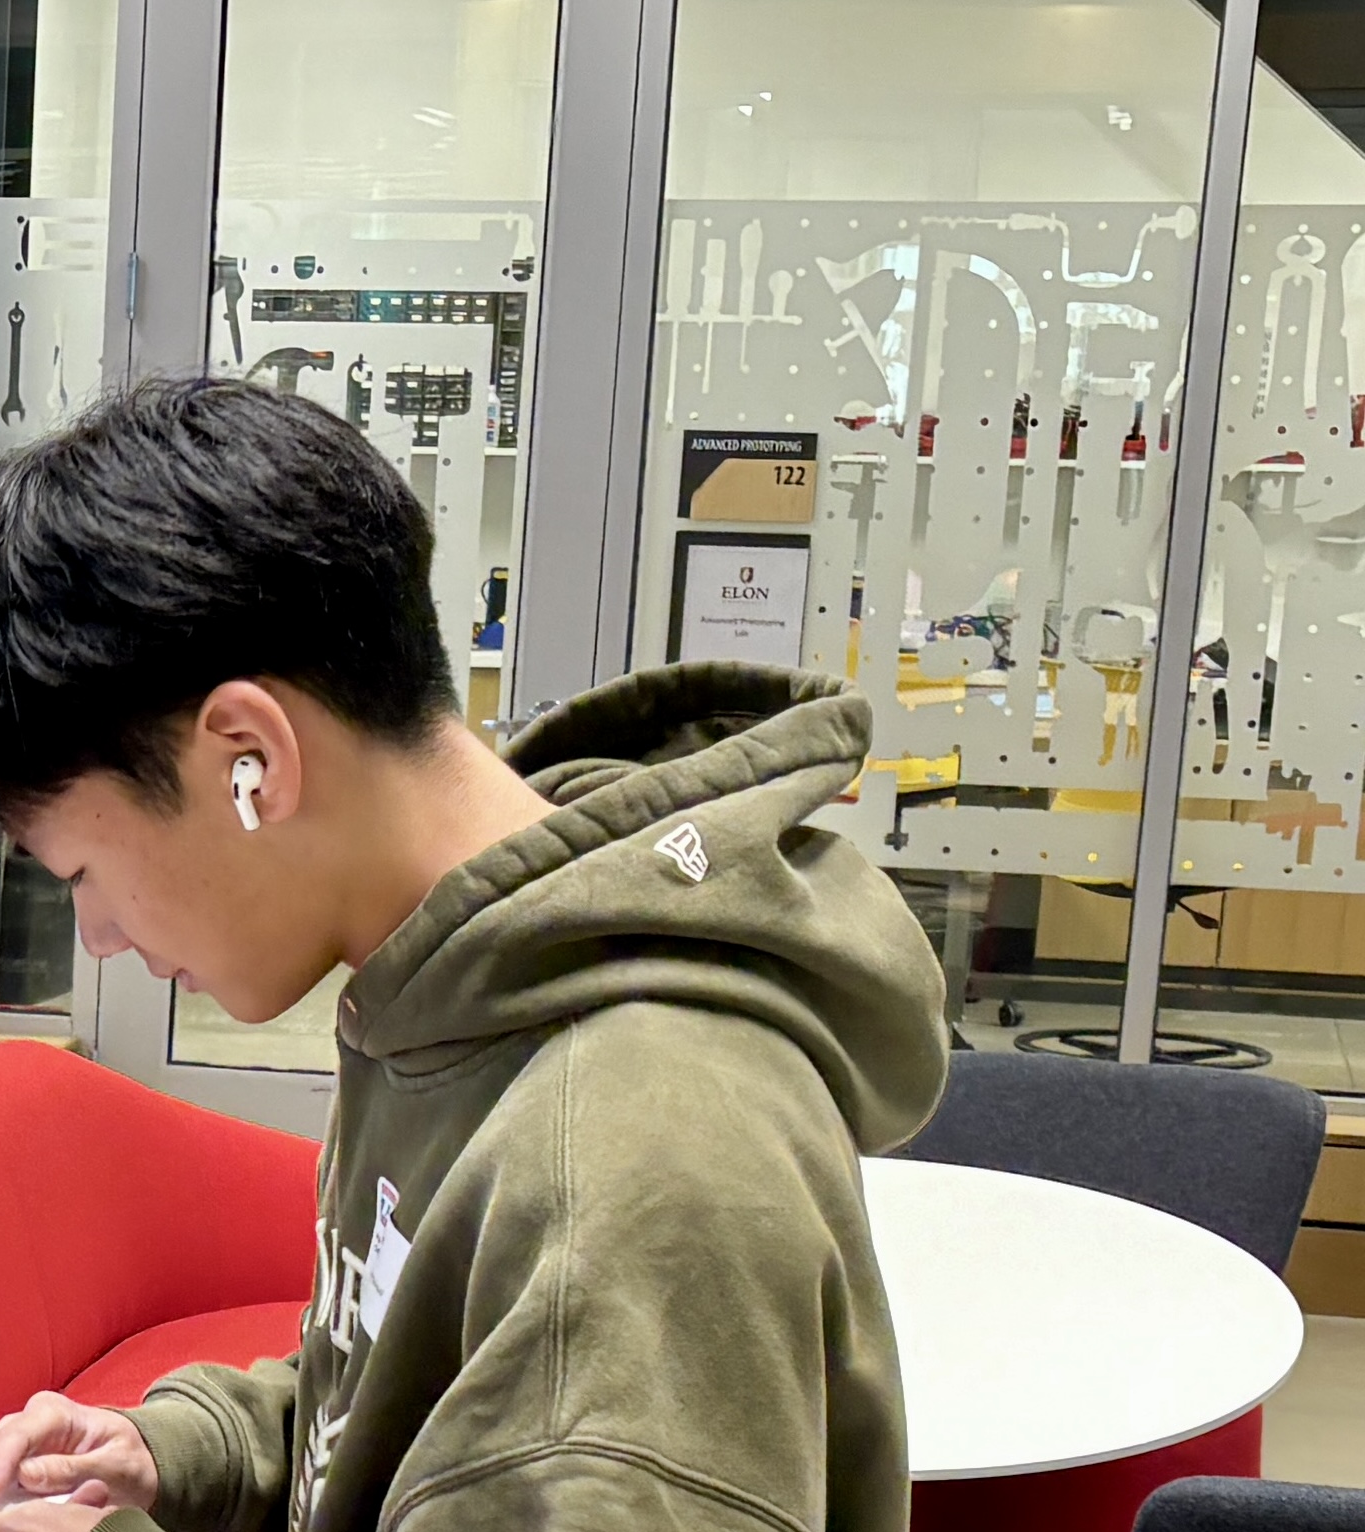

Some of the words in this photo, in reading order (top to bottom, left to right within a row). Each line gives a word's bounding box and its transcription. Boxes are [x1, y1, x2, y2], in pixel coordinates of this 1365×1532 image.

[691, 437, 739, 452] ADVANCED
[740, 439, 803, 454] PROTOTYPING
[774, 465, 806, 486] 122
[721, 586, 769, 600] ELON
